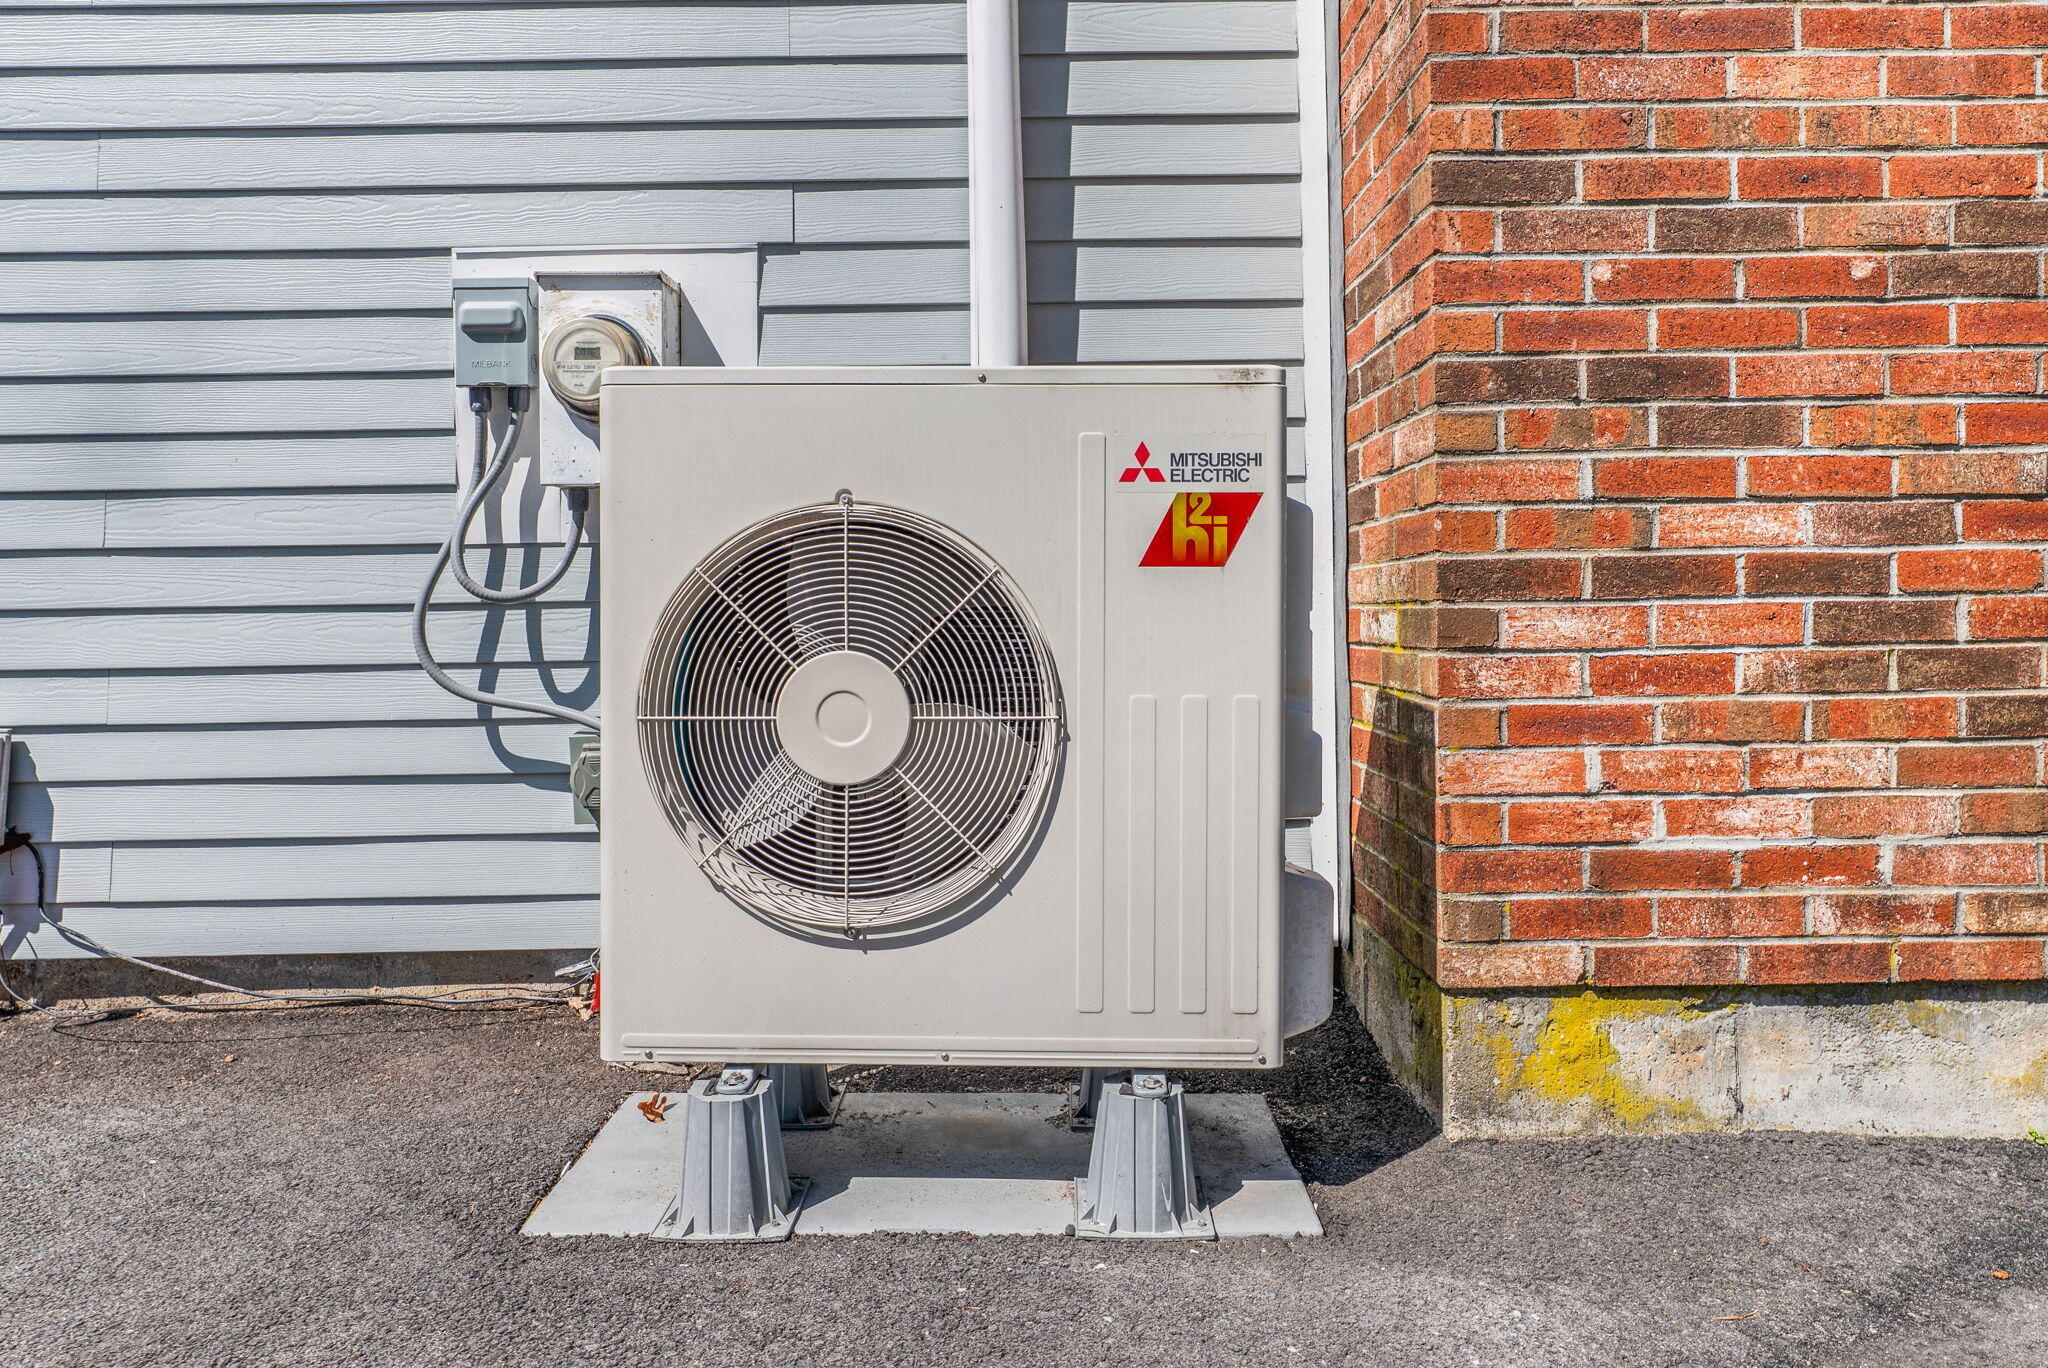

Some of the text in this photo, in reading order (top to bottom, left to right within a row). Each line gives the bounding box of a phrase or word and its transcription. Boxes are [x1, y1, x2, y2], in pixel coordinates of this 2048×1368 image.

[471, 359, 513, 369] MILBANK
[1170, 452, 1262, 467] MITSUBISHI
[1170, 468, 1250, 483] ELECTRIC
